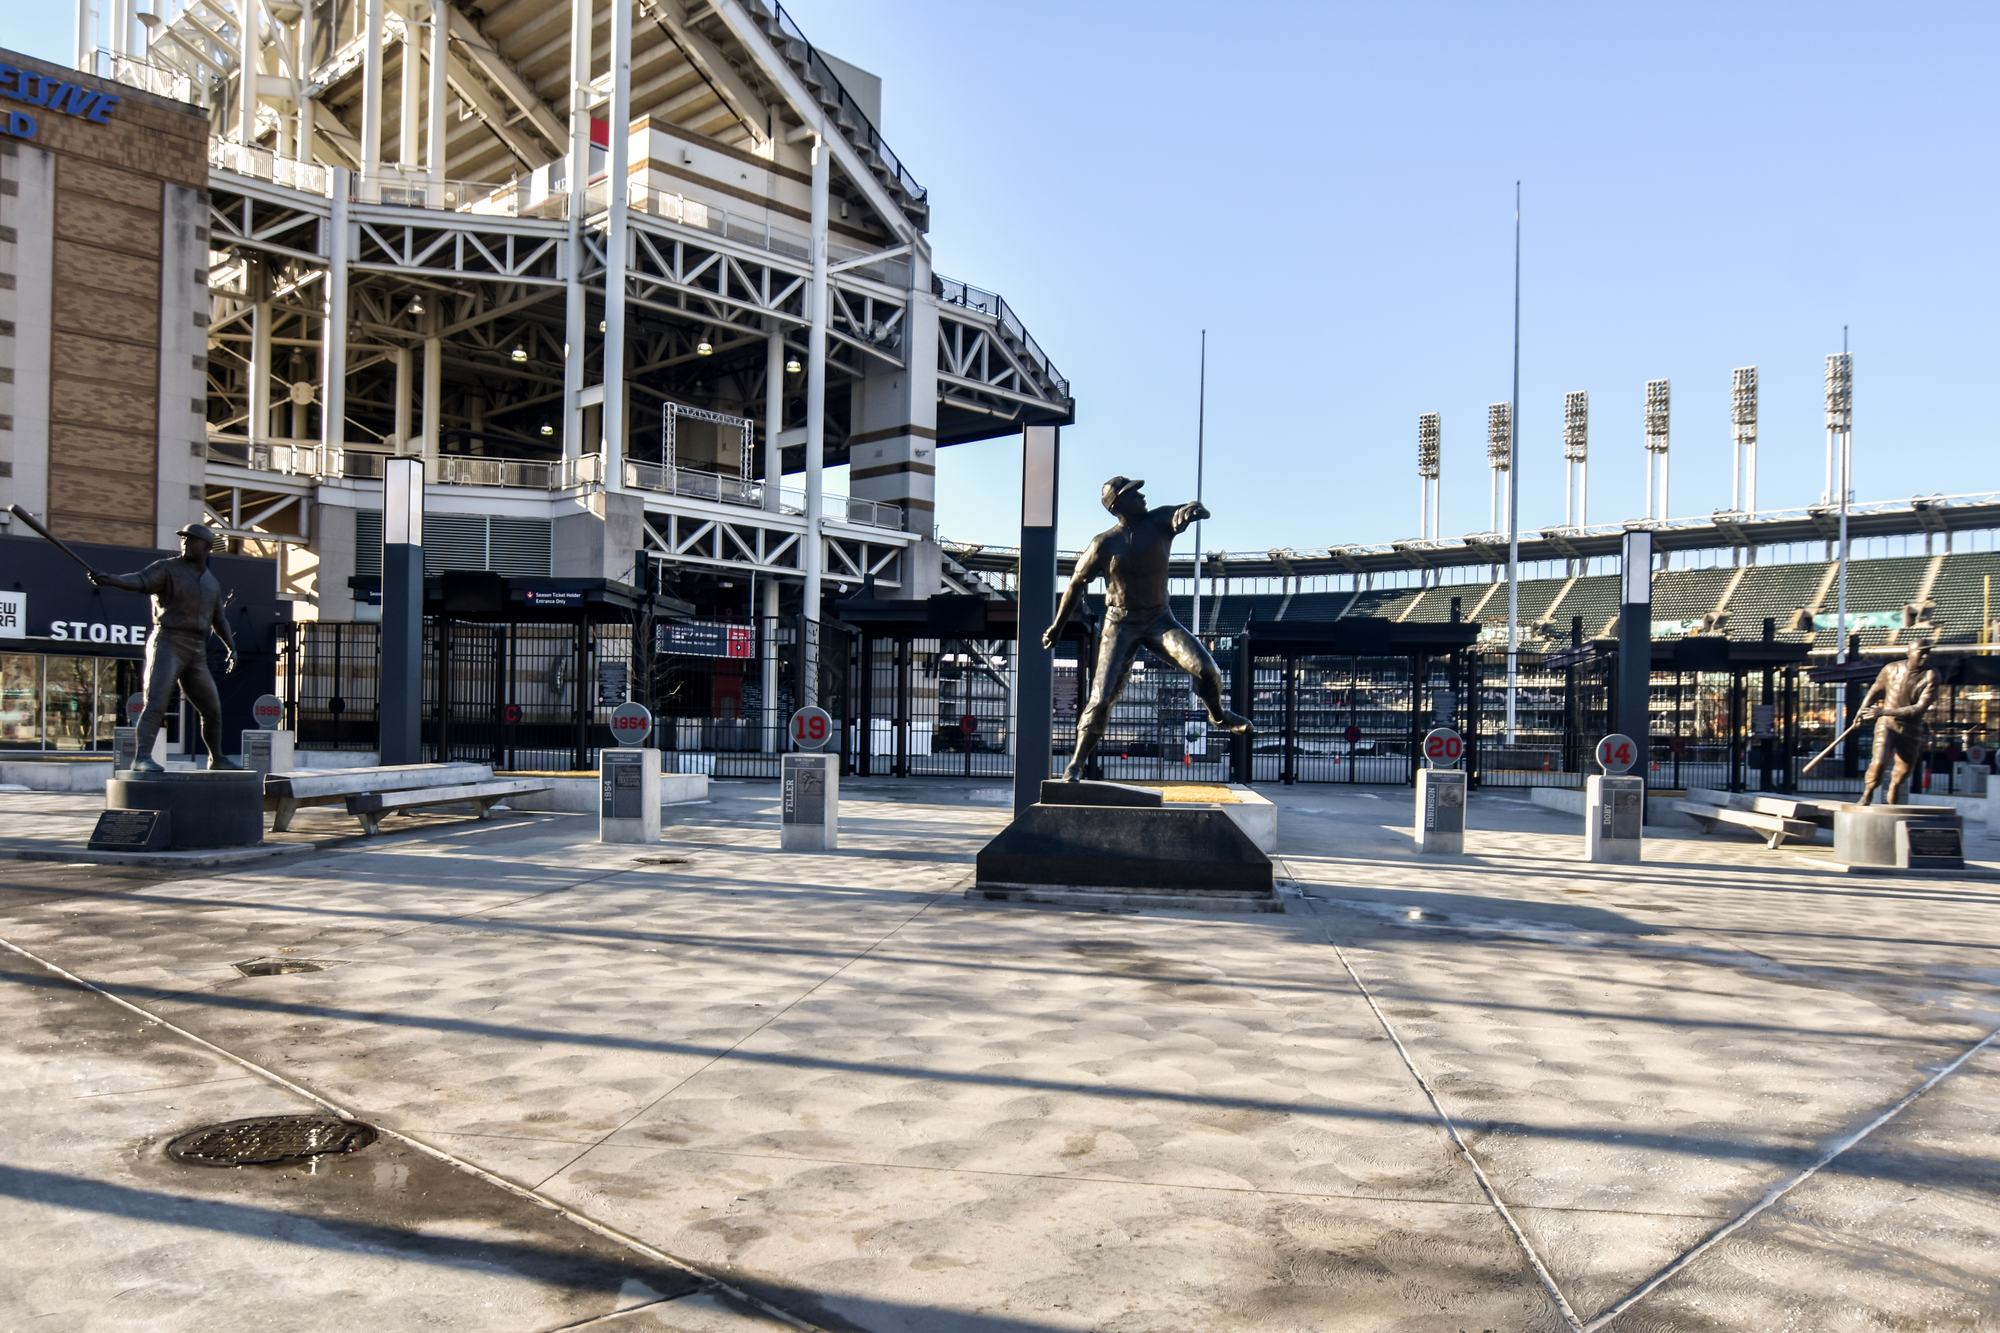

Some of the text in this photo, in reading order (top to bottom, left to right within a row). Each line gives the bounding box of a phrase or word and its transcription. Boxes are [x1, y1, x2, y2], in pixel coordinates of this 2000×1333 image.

[50, 620, 147, 646] STORE
[613, 717, 648, 730] 1954
[796, 715, 827, 740] 19
[1428, 736, 1460, 759] 20
[1603, 742, 1631, 765] 14
[604, 780, 612, 801] 1954
[785, 779, 794, 813] FELLER
[1426, 787, 1436, 828] ROBINSON
[1603, 803, 1612, 825] DOBY
